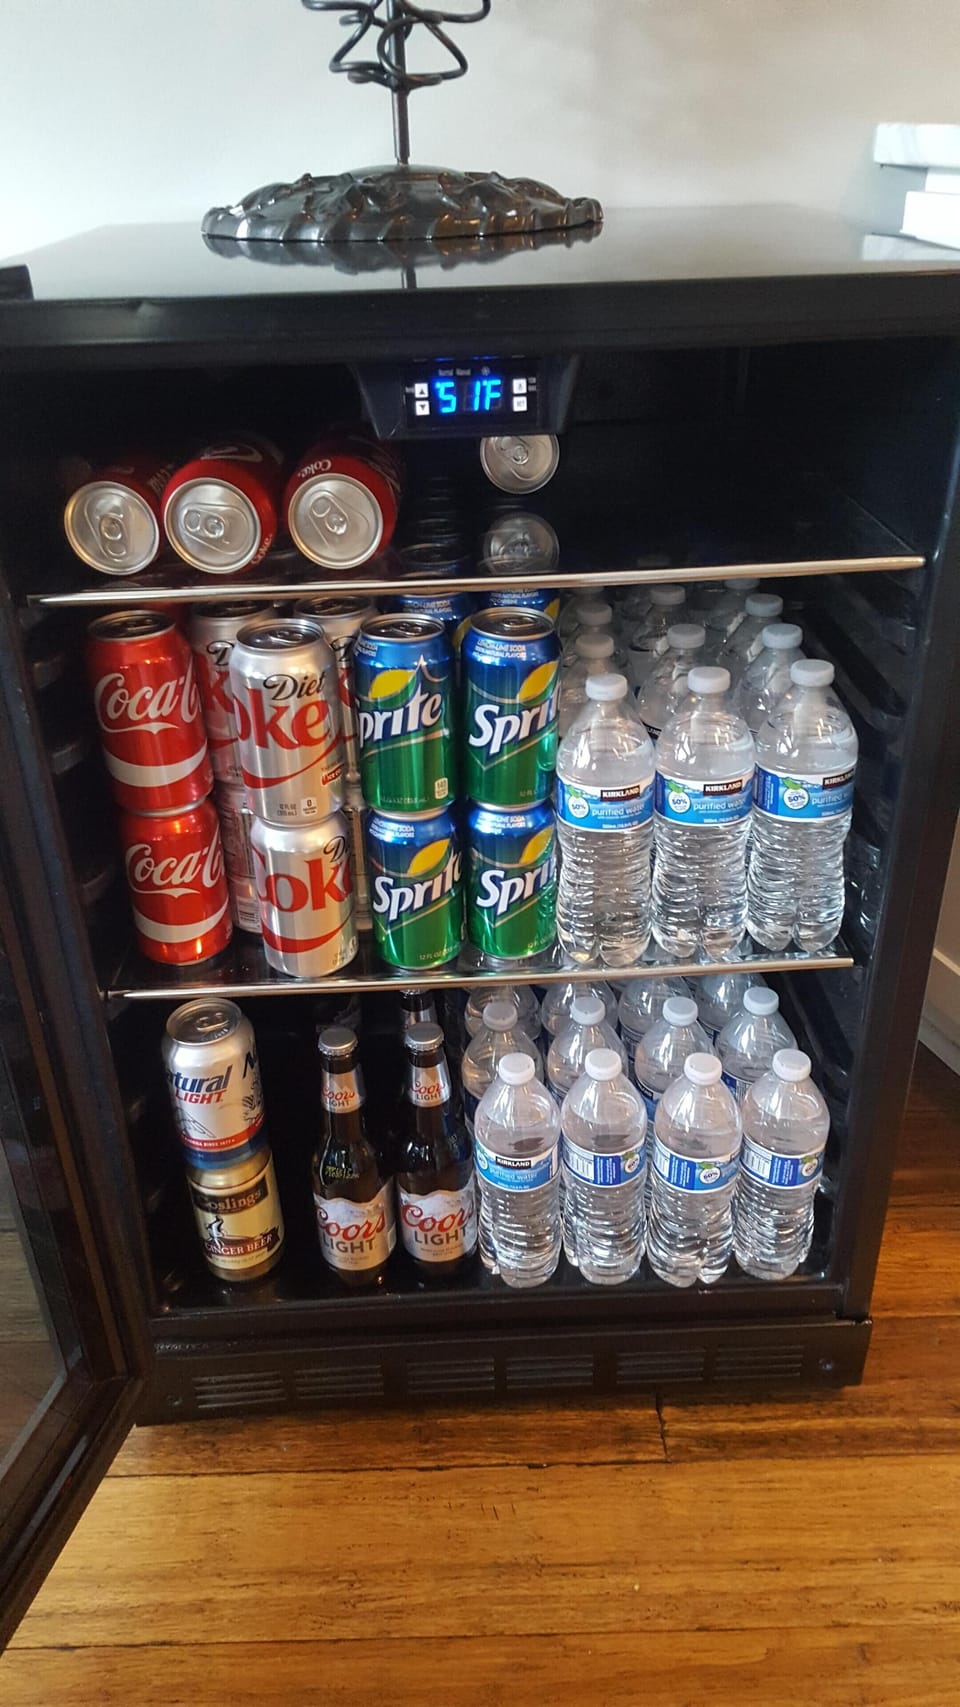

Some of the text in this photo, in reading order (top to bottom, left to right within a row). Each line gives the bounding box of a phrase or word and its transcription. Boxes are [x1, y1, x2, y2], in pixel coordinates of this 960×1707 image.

[263, 671, 325, 700] Diet
[356, 683, 442, 749] prite
[602, 787, 640, 797] KIRKLAND
[705, 781, 742, 792] KIRKLAND
[591, 807, 624, 818] purified
[168, 1065, 233, 1093] tural
[410, 1080, 446, 1095] Coors
[175, 1088, 227, 1105] LIGHT
[322, 1087, 355, 1101] Coors
[416, 1092, 442, 1101] LIGHT
[497, 1157, 530, 1168] KIRKLAND
[200, 1190, 261, 1210] oslings
[316, 1206, 386, 1241] Coors
[247, 1233, 273, 1253] BEER
[322, 1231, 375, 1254] LIGHT
[414, 1226, 468, 1246] LIGHT
